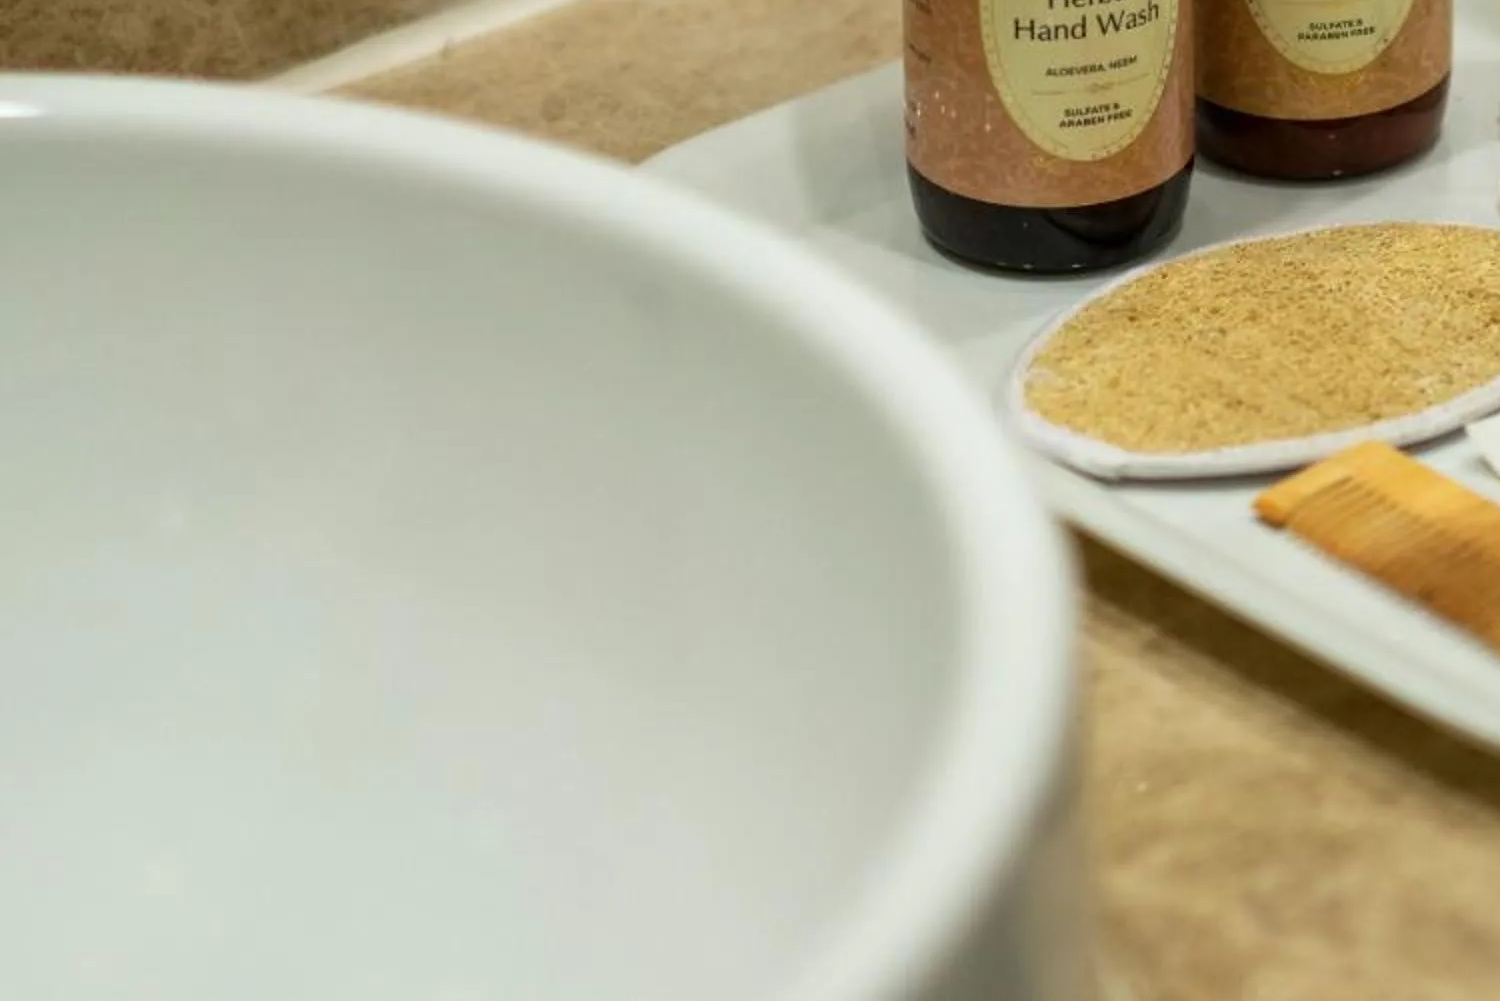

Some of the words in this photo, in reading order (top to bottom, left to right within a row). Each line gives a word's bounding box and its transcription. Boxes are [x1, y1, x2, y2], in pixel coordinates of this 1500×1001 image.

[1013, 15, 1087, 42] Hand
[1096, 0, 1159, 36] Wash
[1308, 19, 1353, 31] SULFATE
[1297, 30, 1349, 42] PARABEN
[1351, 26, 1376, 36] FREE
[1108, 55, 1138, 70] NEEM
[1064, 103, 1112, 117] SULFATE
[1107, 108, 1133, 122] FREE
